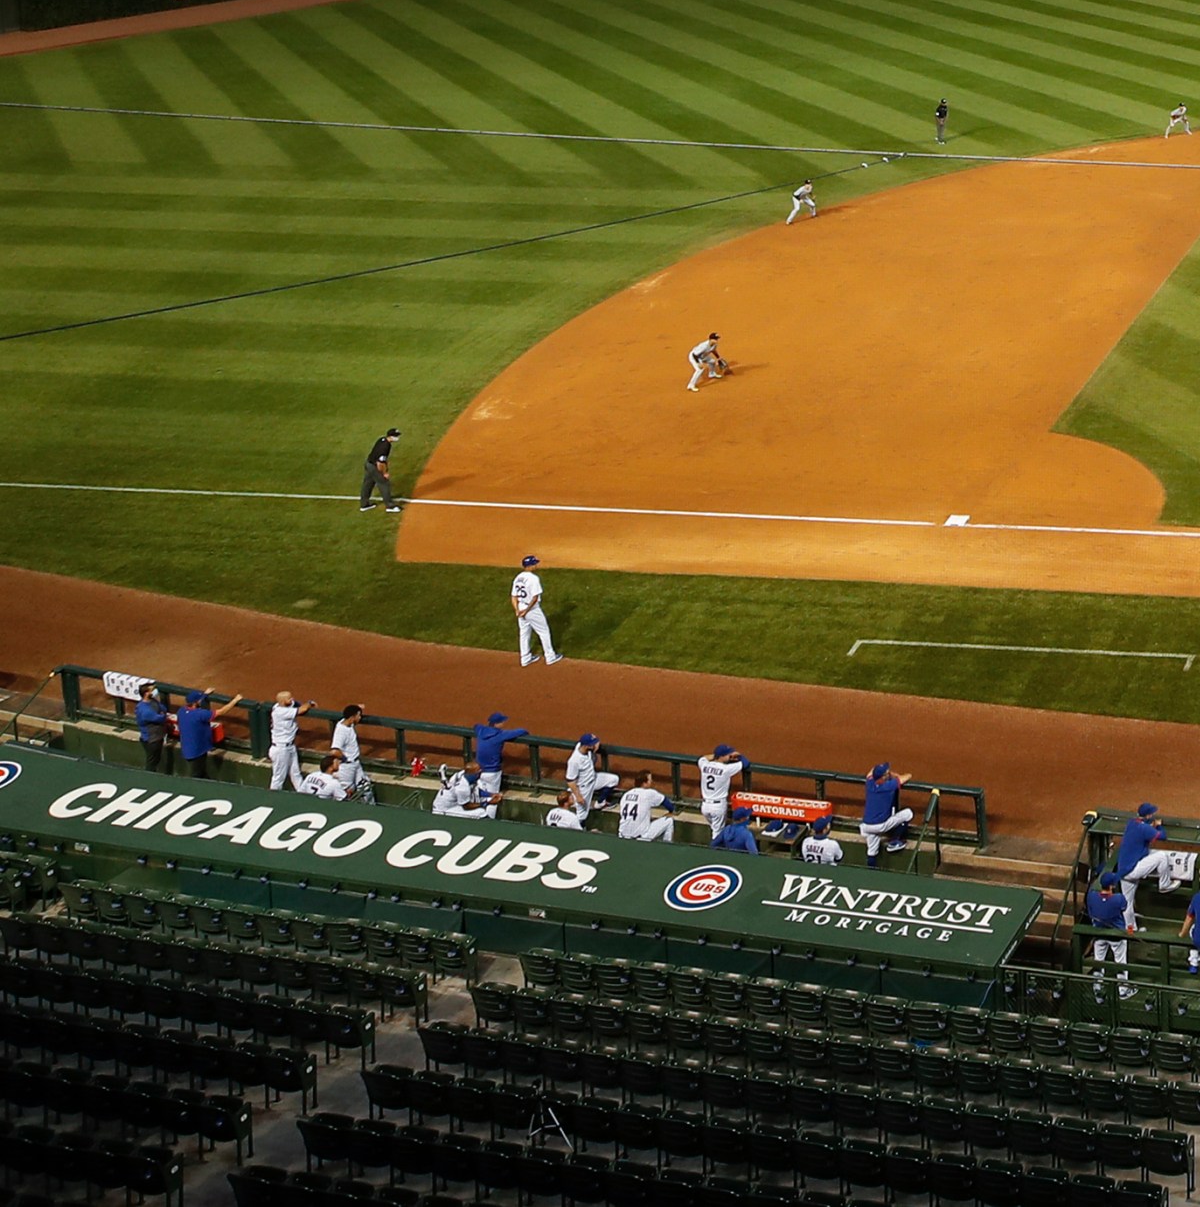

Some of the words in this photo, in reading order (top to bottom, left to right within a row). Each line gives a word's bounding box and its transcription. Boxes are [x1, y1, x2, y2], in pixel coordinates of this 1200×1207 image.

[706, 775, 716, 790] 2
[622, 803, 638, 821] 44
[752, 804, 806, 818] GATORADE
[48, 782, 384, 858] CHICAGO
[386, 830, 610, 890] CUBS
[778, 873, 1011, 928] WINTRUST
[784, 910, 953, 942] MORTGAGE
